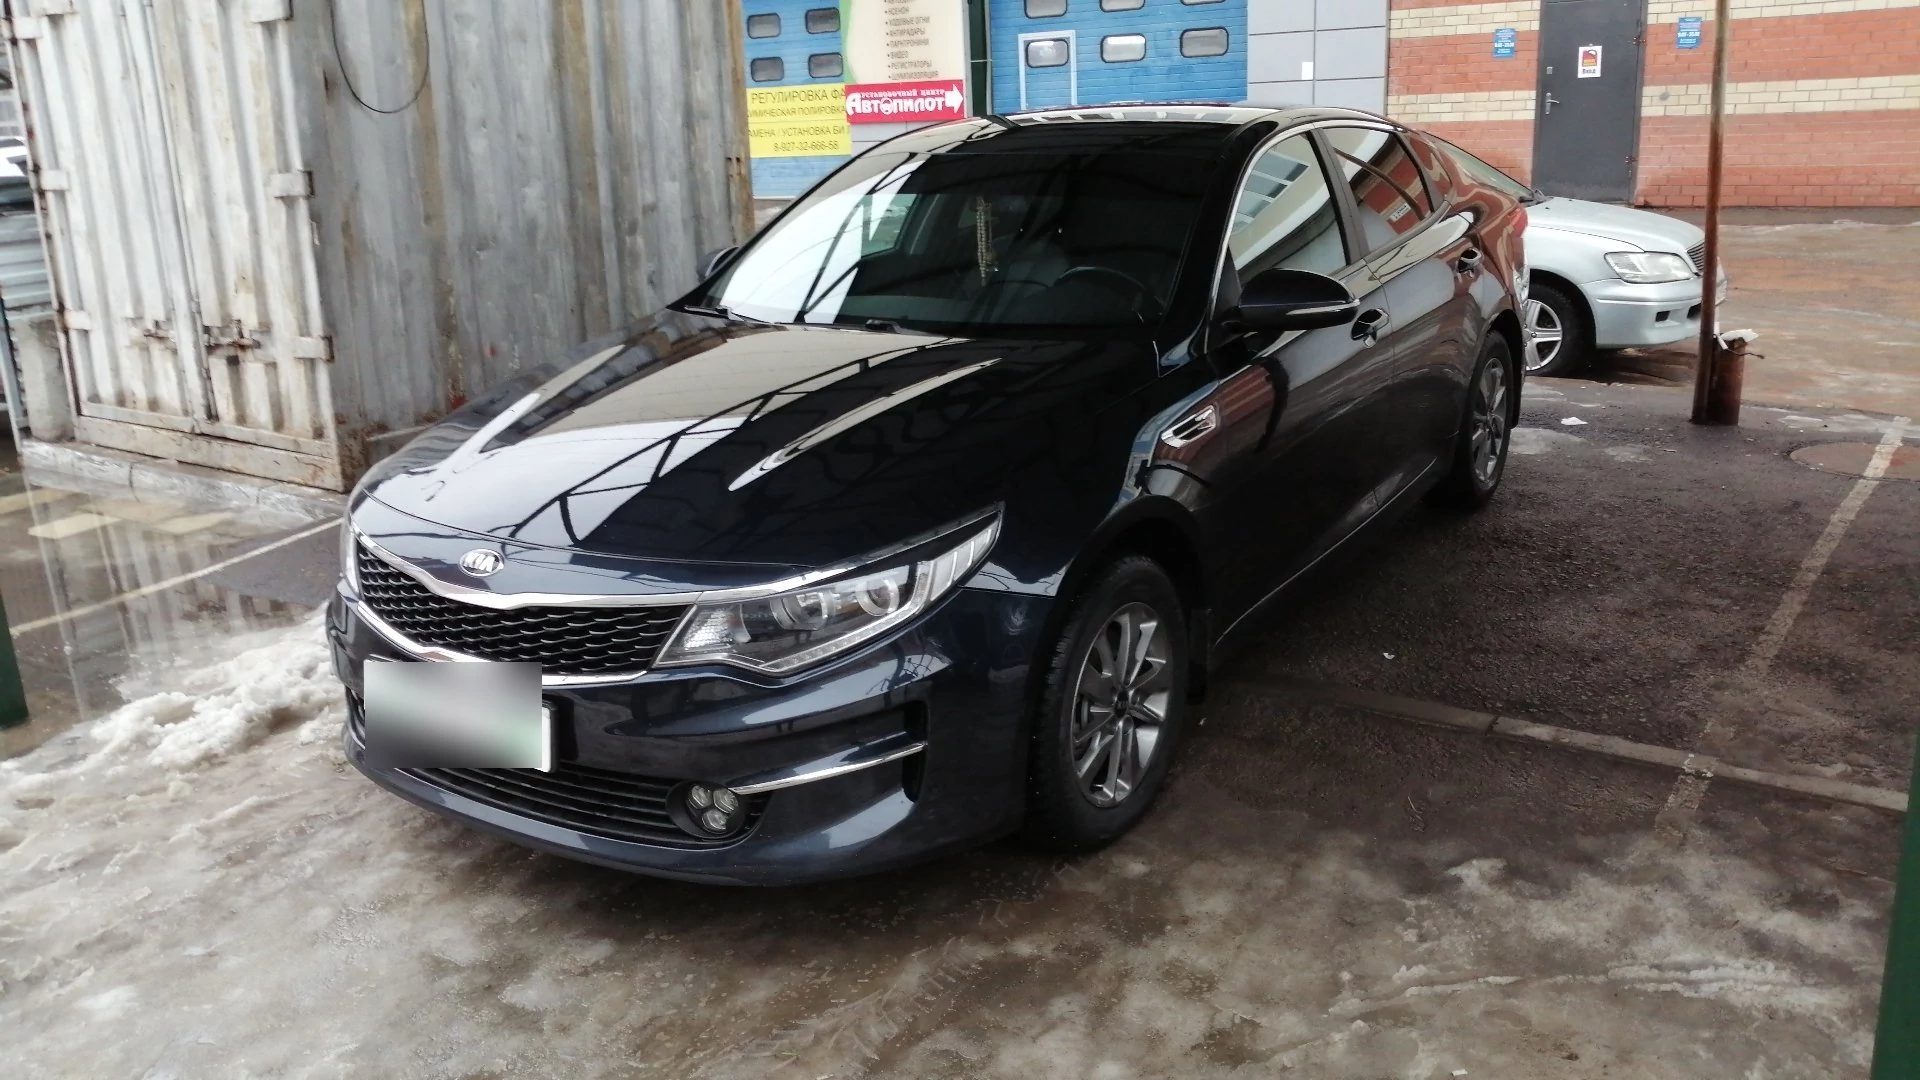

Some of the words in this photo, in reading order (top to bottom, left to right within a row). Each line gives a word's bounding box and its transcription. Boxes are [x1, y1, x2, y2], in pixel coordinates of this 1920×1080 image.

[751, 89, 828, 104] РЕГУЛИРОВКА
[748, 107, 797, 118] ИМИЧЕСКАЯ
[782, 126, 830, 138] УСТАНОВКА
[462, 551, 497, 573] KIA
